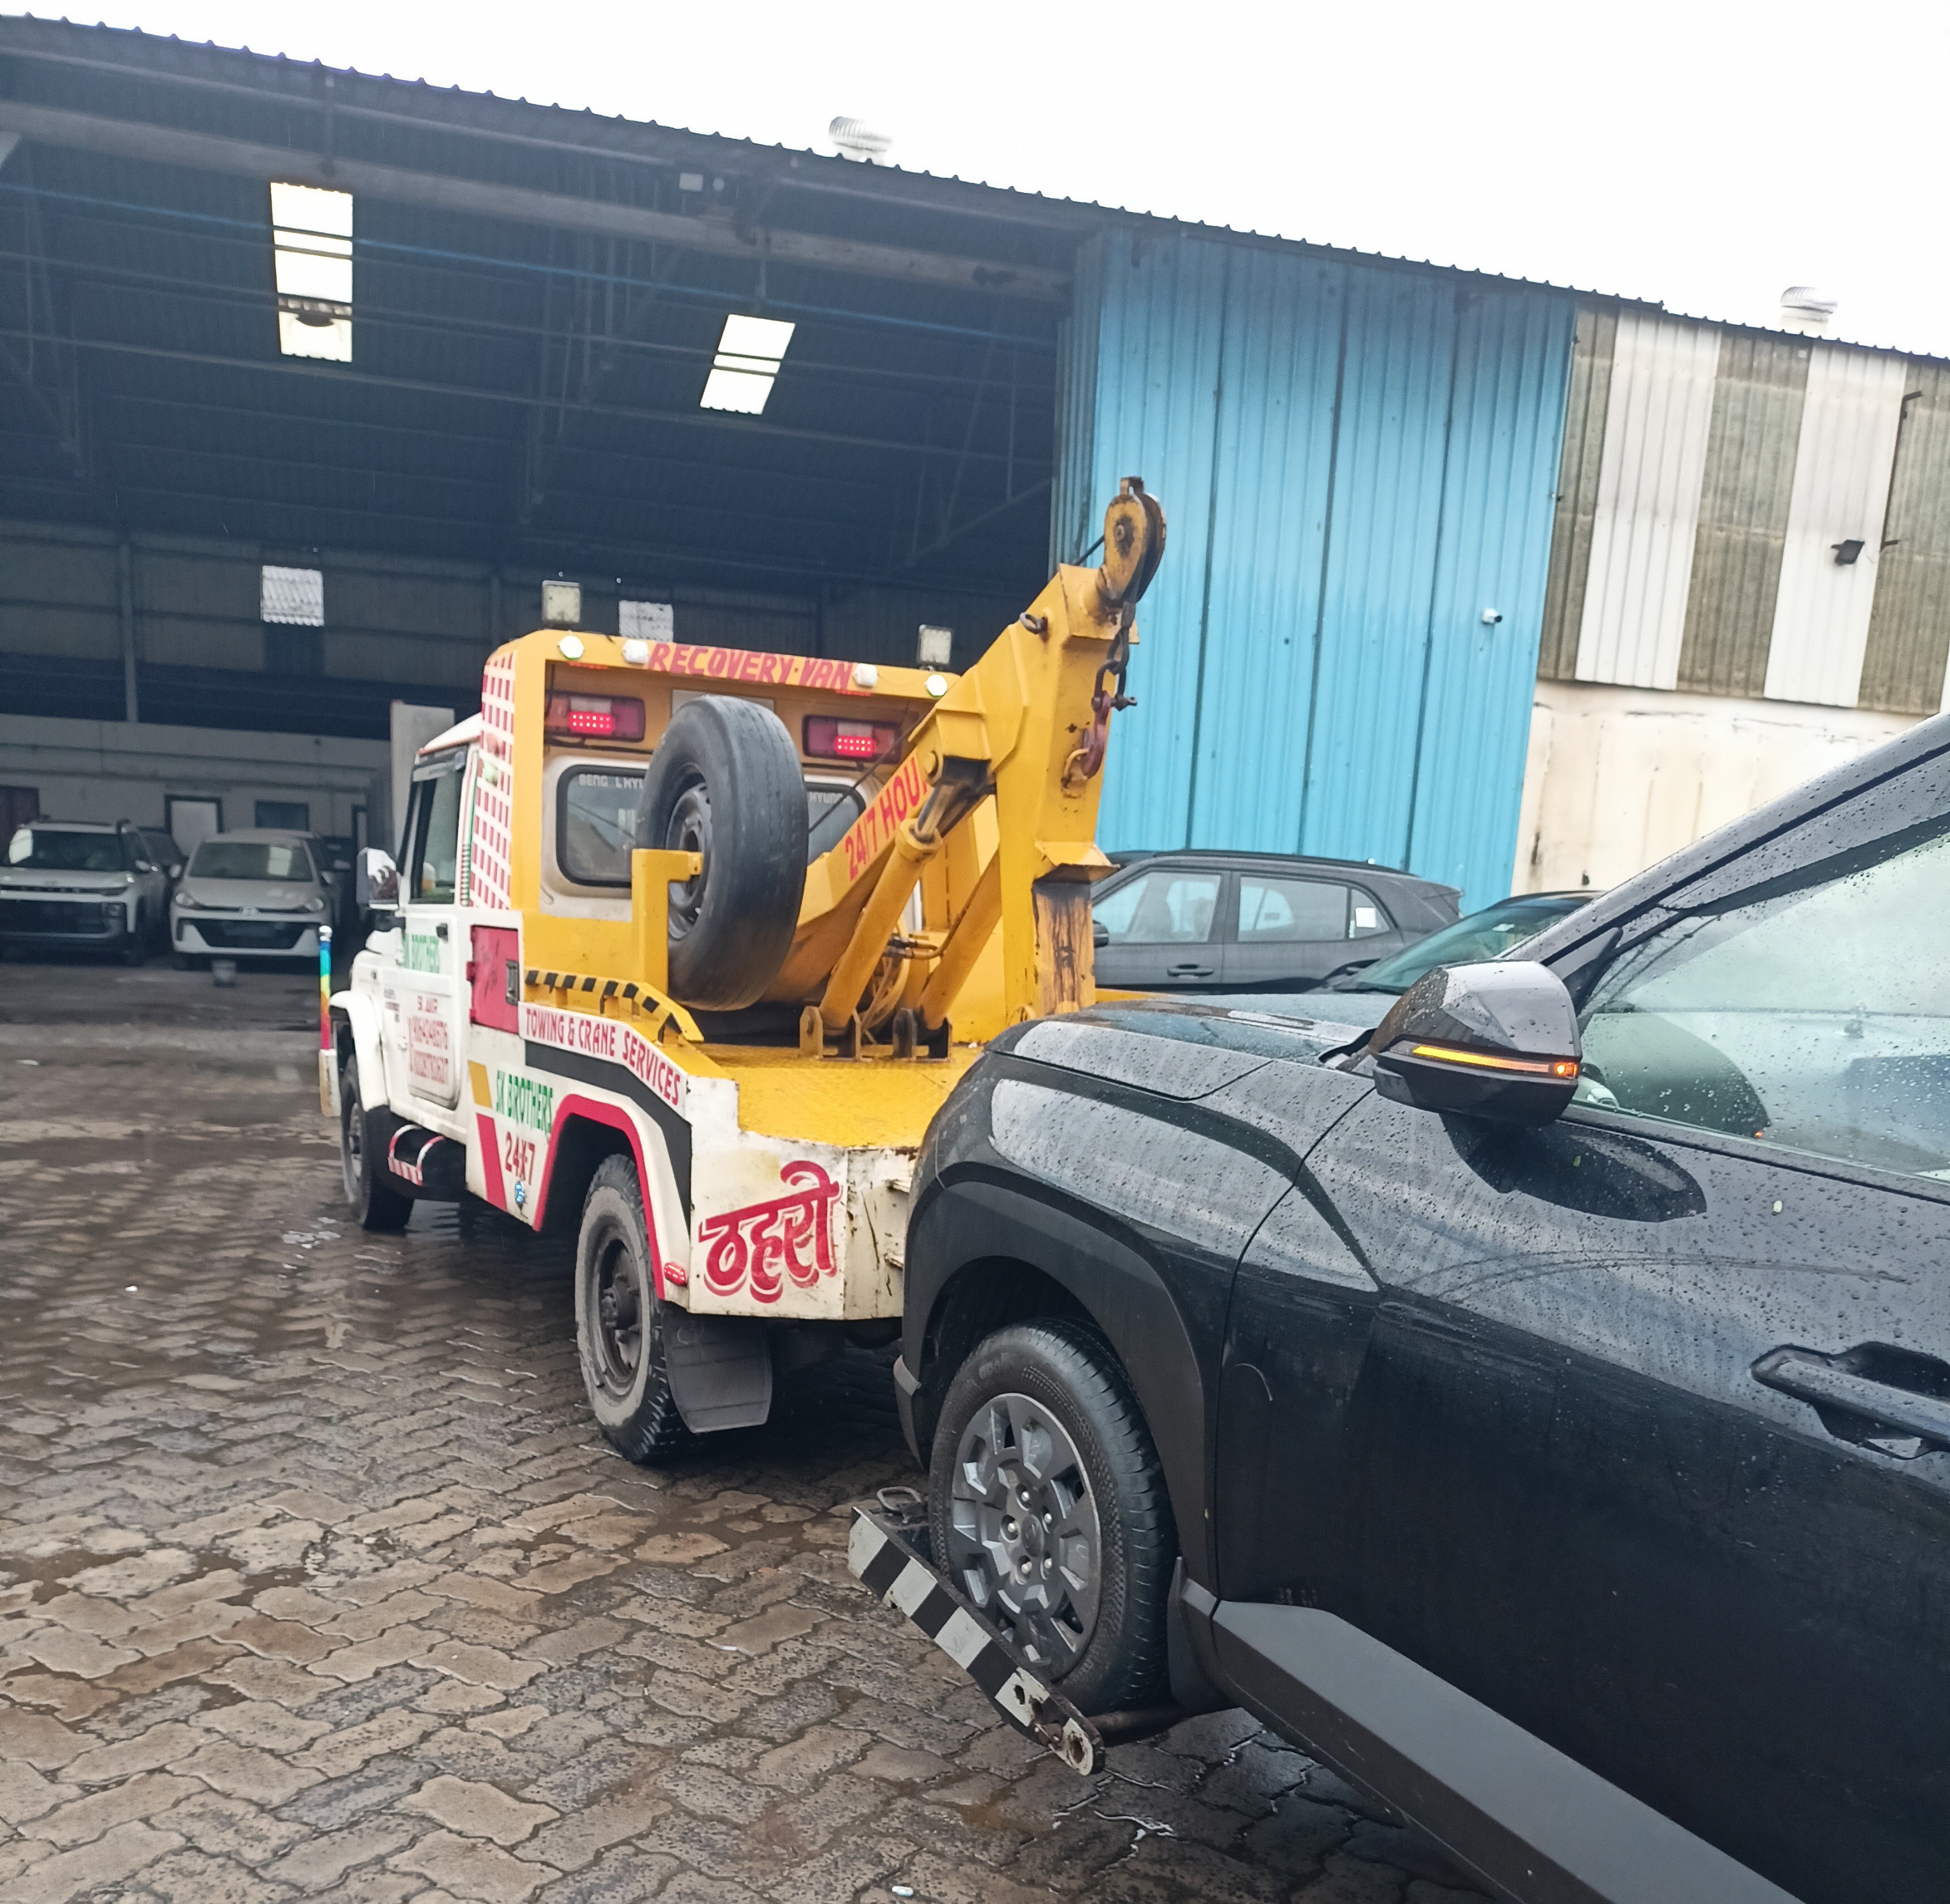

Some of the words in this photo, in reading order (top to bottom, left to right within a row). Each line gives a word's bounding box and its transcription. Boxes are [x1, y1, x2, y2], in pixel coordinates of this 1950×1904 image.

[845, 807, 877, 882] 24/7
[880, 757, 927, 840] HOU
[507, 1074, 553, 1137] BROTHERS
[526, 1008, 564, 1045] TOWING
[568, 1017, 574, 1047] &
[578, 1019, 616, 1057] CRANE
[622, 1031, 680, 1106] SERVICES
